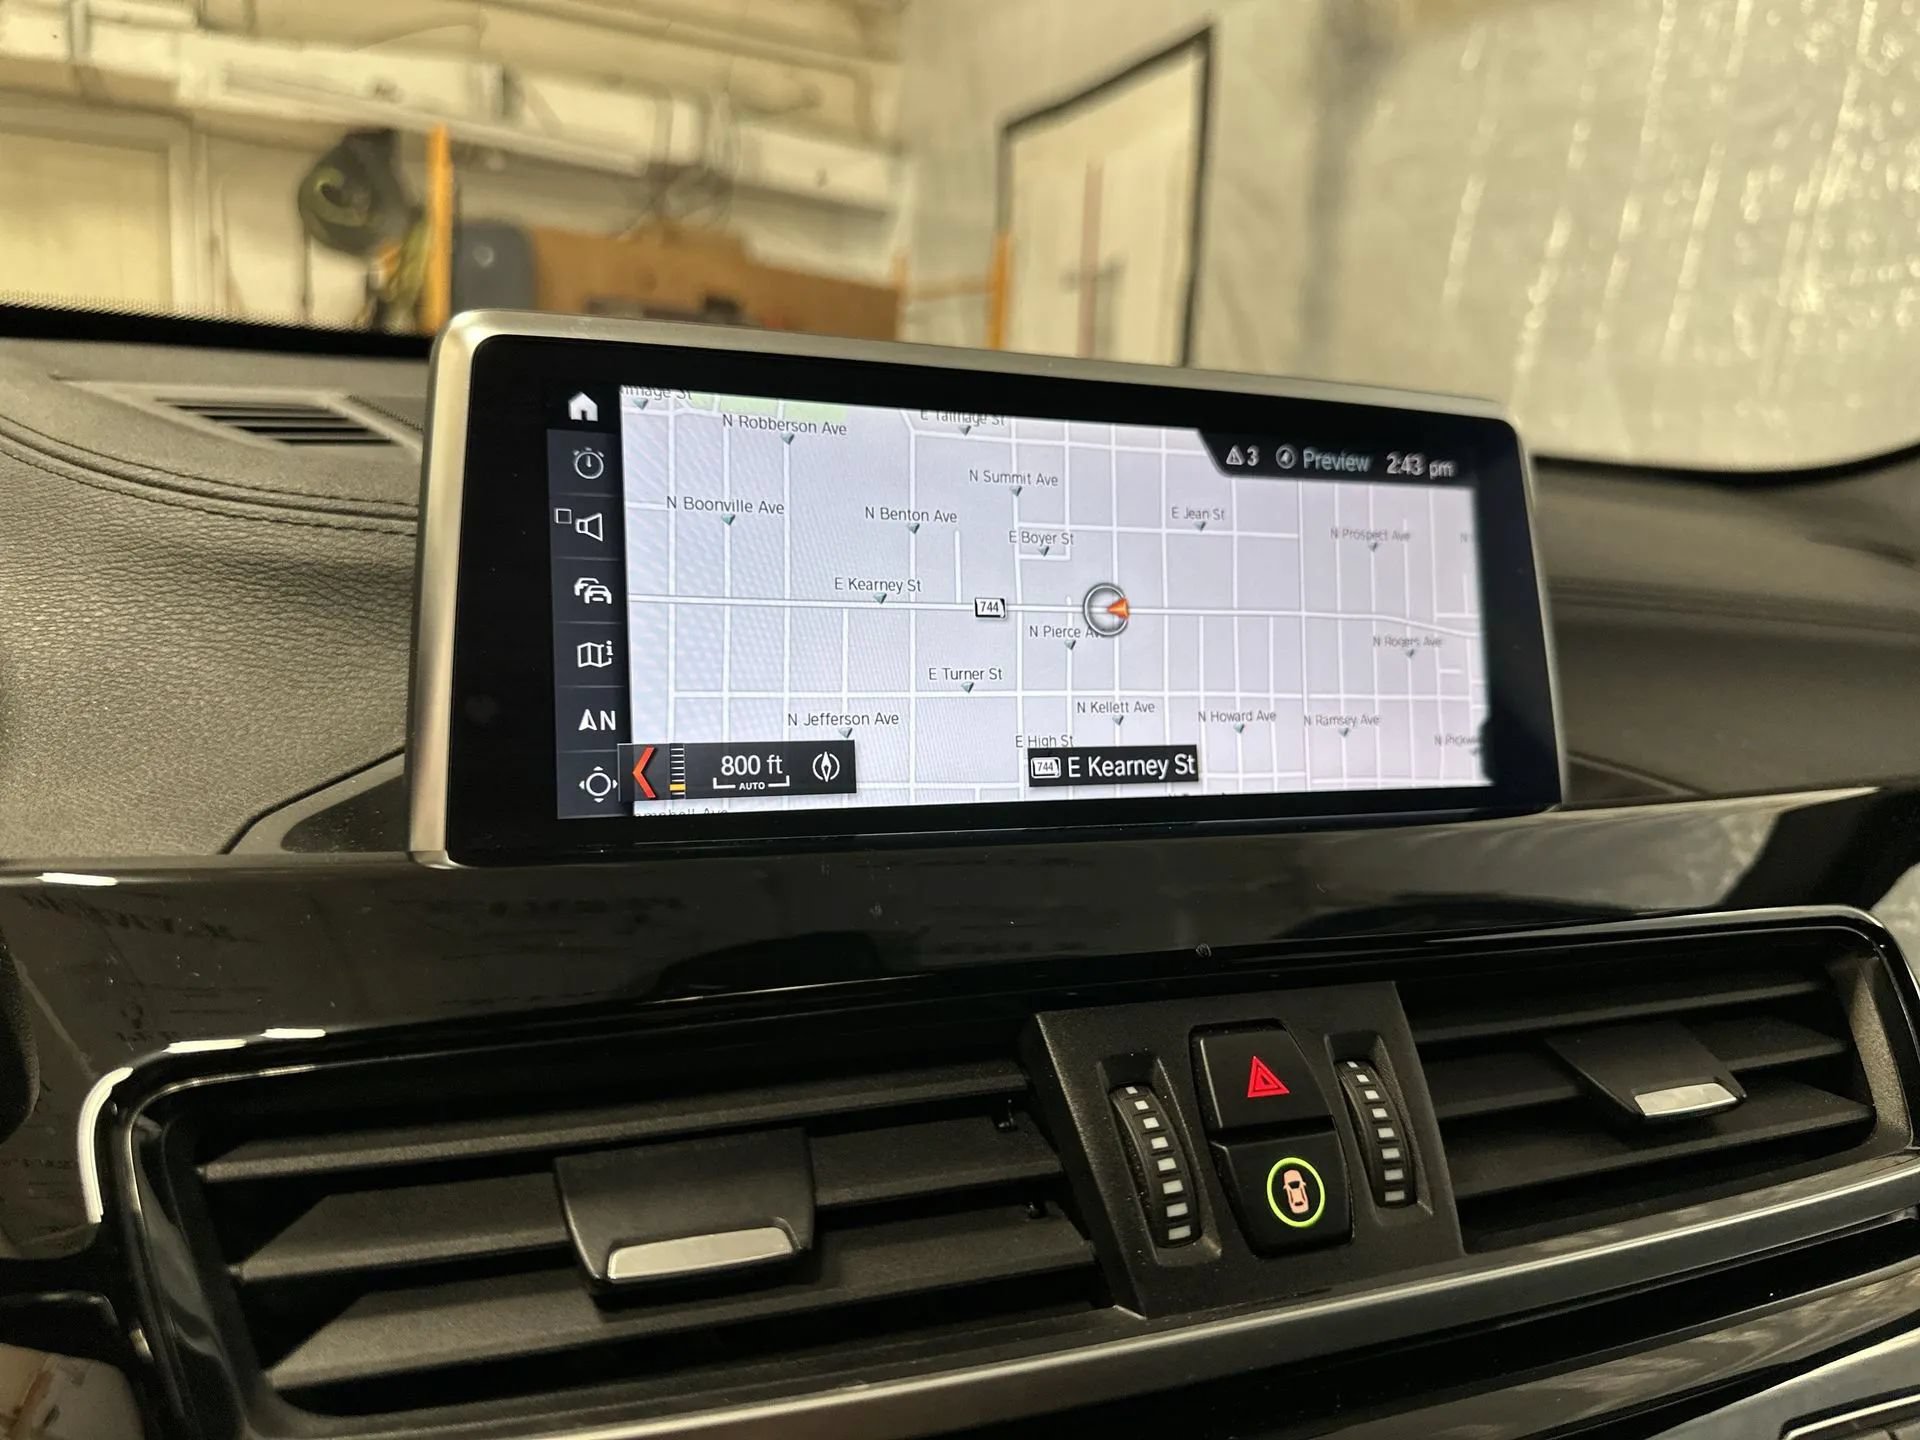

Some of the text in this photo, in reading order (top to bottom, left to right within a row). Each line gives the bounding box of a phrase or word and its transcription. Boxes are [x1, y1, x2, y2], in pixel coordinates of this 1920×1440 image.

[722, 414, 848, 436] N Robberson Ave
[1247, 446, 1260, 467] 3
[1302, 449, 1371, 473] Preview
[1386, 451, 1455, 480] 2:43 pm
[969, 469, 1059, 487] N Summit Ave
[666, 496, 785, 515] N Boonville Ave
[865, 506, 958, 524] N Benton Ave
[1171, 507, 1225, 521] E Jean St
[1009, 530, 1074, 548] E Boyer St
[1330, 528, 1339, 539] N
[834, 577, 922, 595] E Kearney St
[980, 600, 999, 613] 744
[1029, 625, 1039, 638] N
[1043, 626, 1081, 639] Pierce
[928, 667, 1003, 681] E Turner St
[1077, 701, 1156, 714] N Kellett Ave
[787, 711, 900, 727] N Jefferson Ave
[1198, 710, 1277, 723] N Howard Ave
[1304, 714, 1380, 729] N Ramsey Ave
[1015, 734, 1074, 748] E High St
[720, 753, 783, 776] 800 ft
[1037, 762, 1054, 772] 744
[1067, 753, 1196, 780] E Kearney St
[738, 781, 766, 791] AUTO
